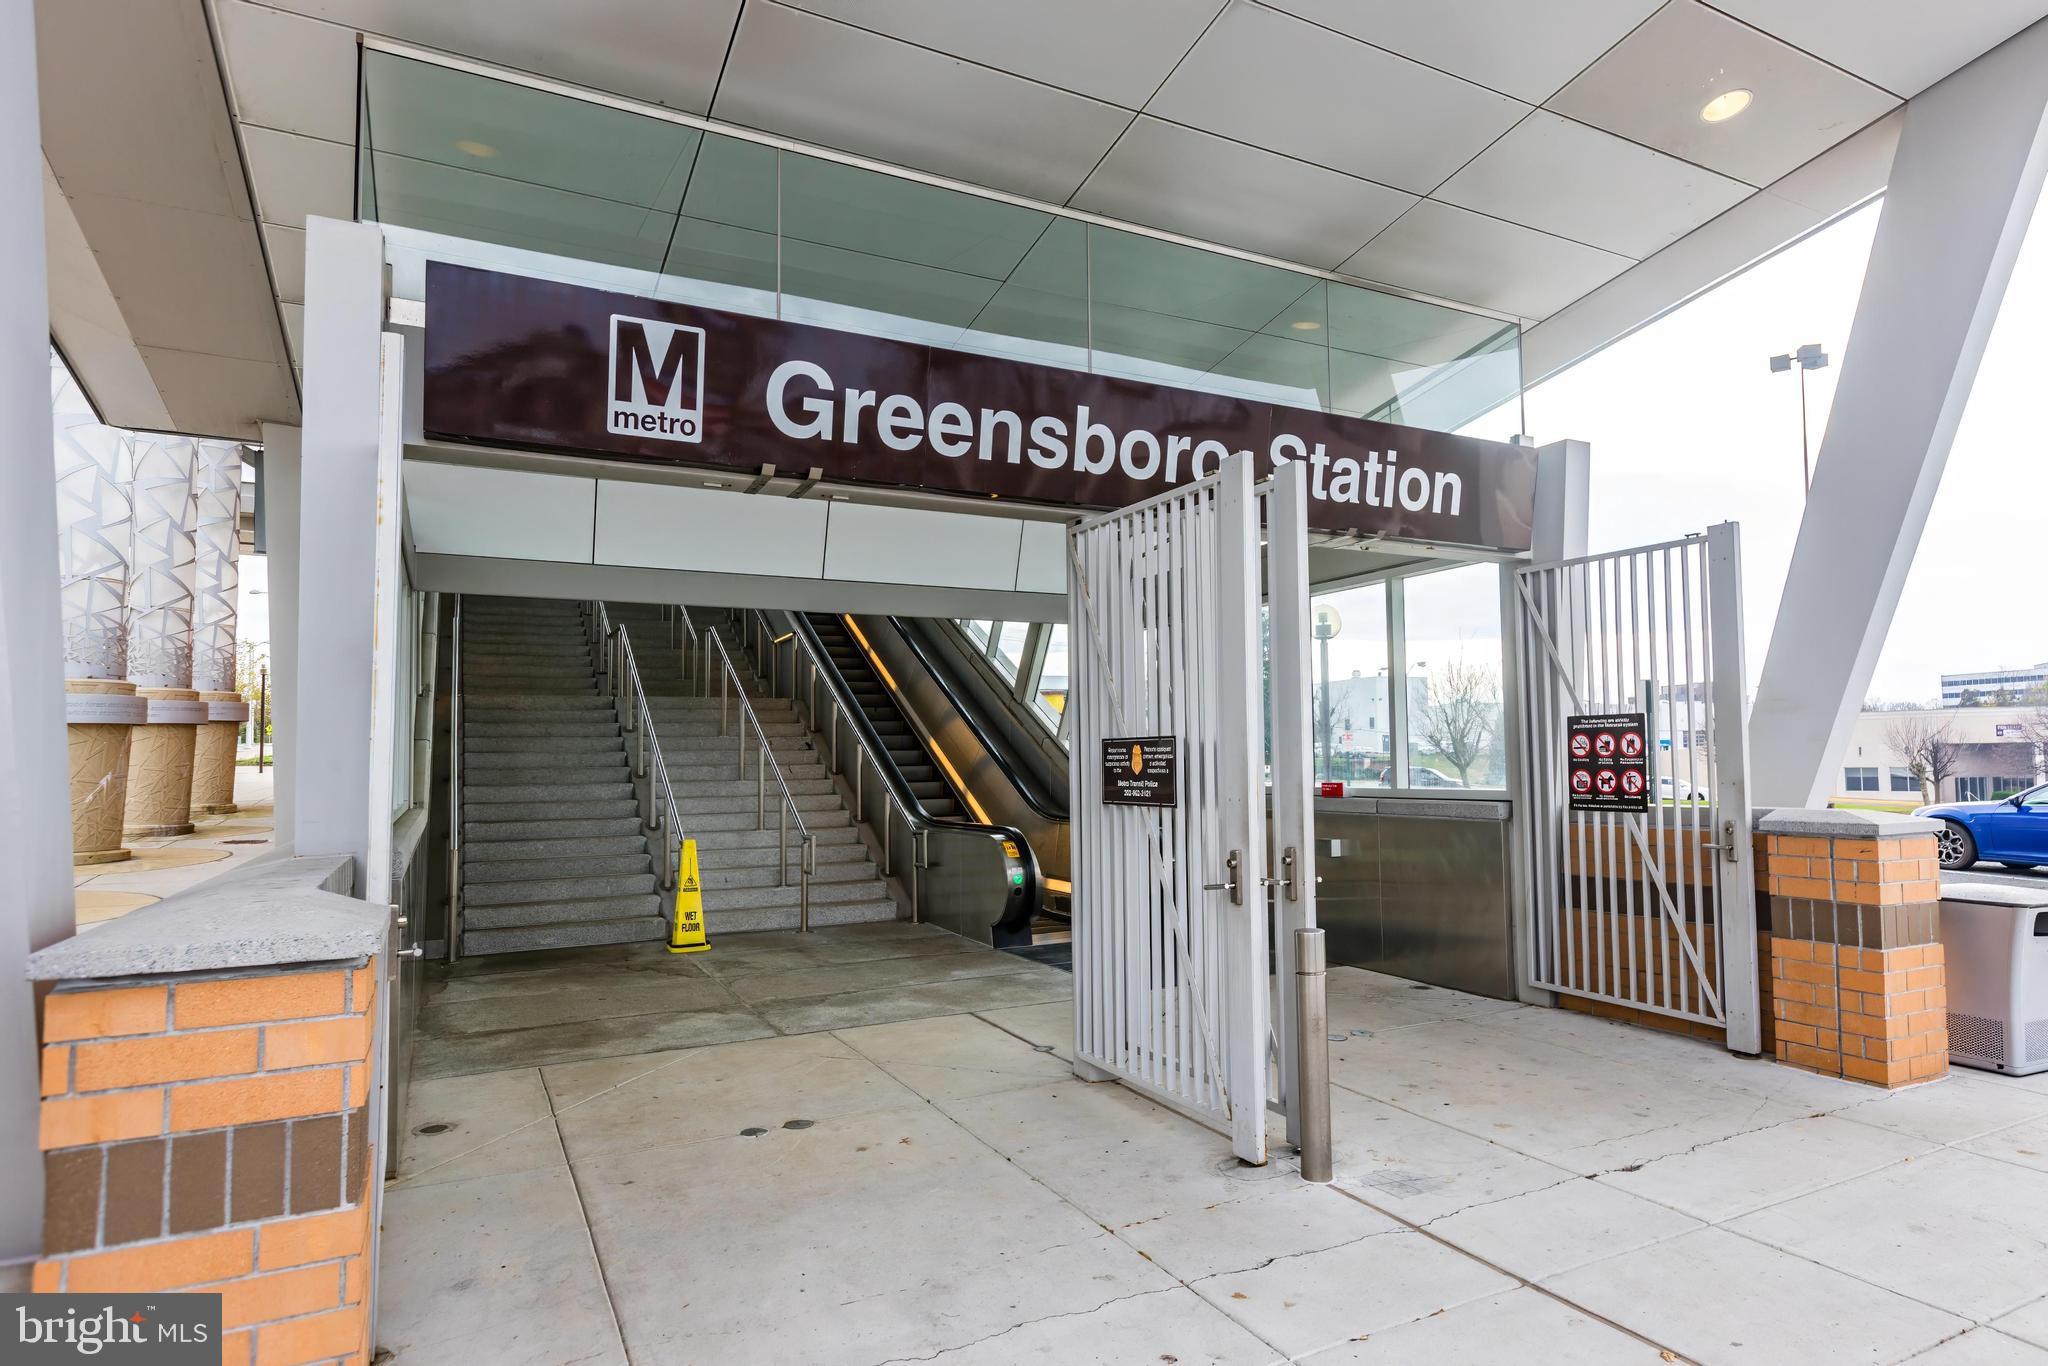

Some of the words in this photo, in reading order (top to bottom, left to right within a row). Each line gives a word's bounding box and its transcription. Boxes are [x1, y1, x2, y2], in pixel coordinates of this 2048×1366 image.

[614, 319, 700, 411] M
[614, 410, 696, 436] metro
[765, 359, 1230, 484] Greensboro
[682, 922, 700, 933] FLOOR
[685, 911, 697, 921] WET
